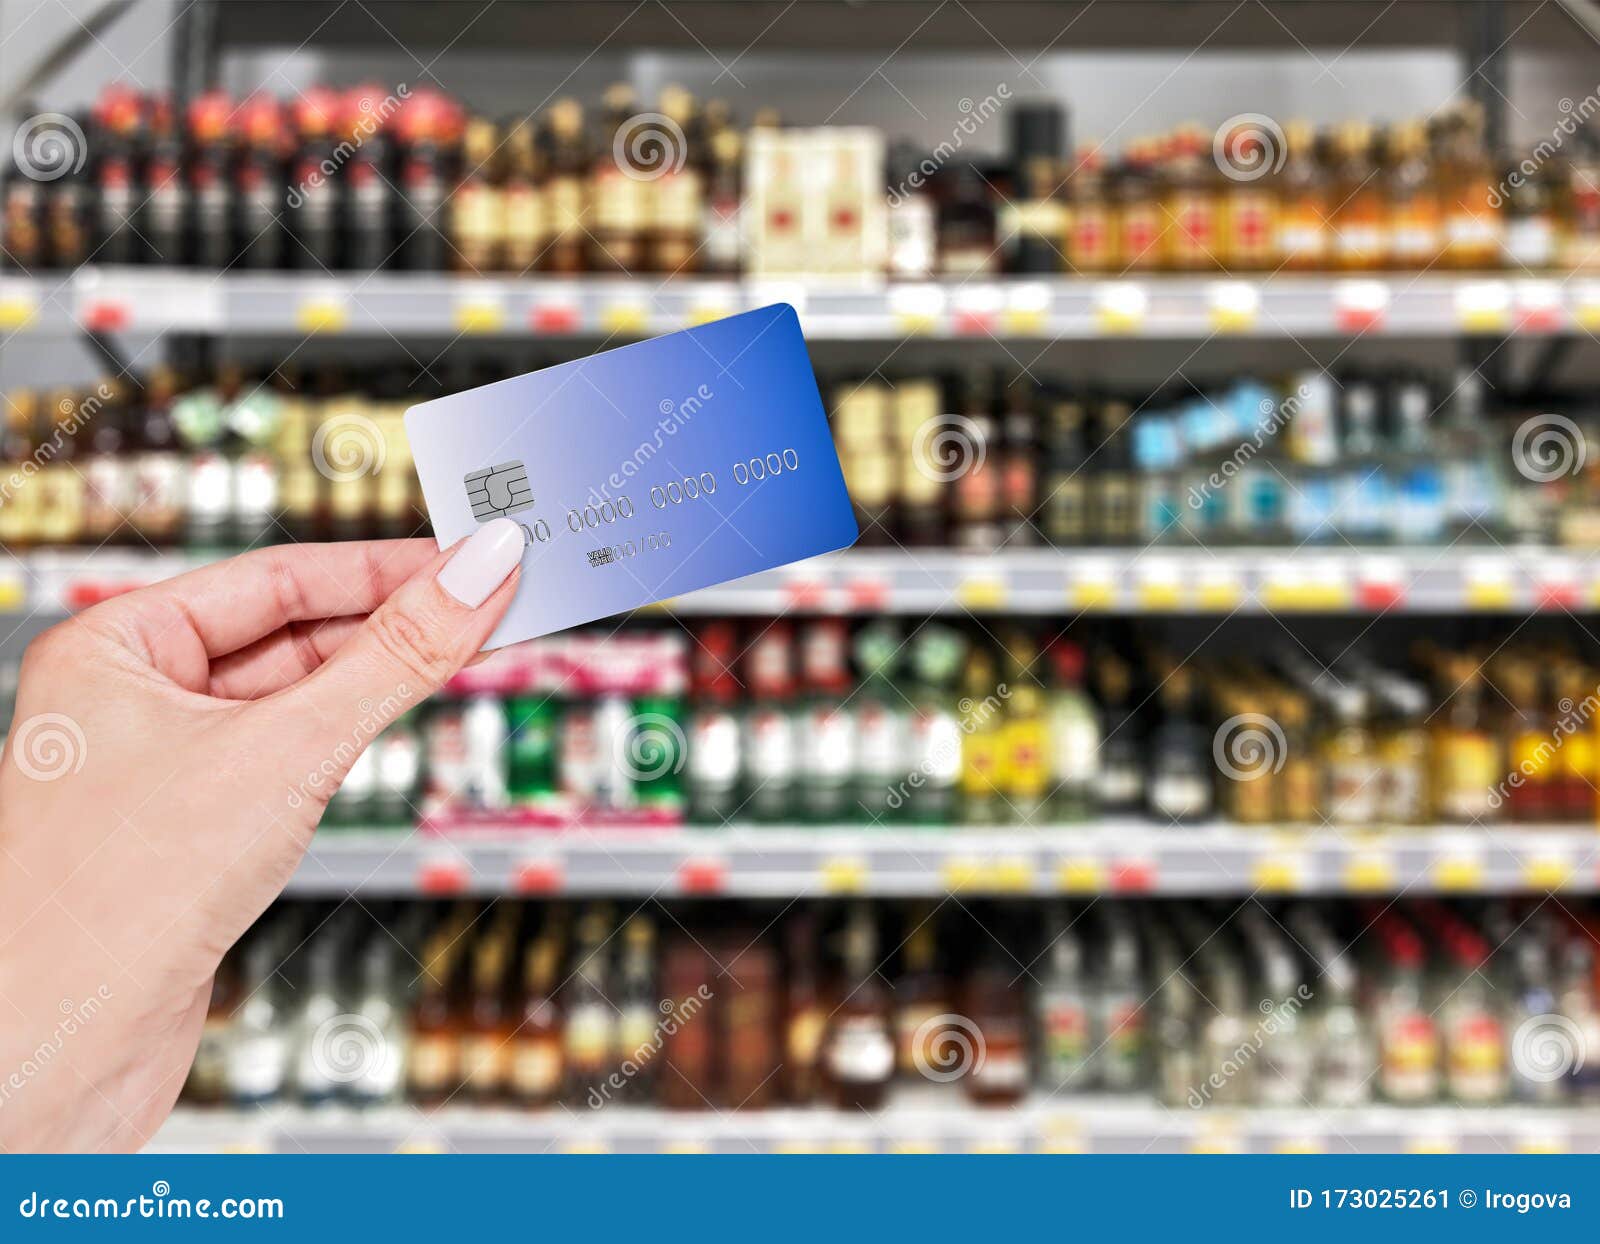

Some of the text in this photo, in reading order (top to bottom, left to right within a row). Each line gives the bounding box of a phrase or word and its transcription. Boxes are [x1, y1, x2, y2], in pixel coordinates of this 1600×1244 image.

[567, 495, 634, 533] 0000
[651, 471, 717, 509] 0000
[733, 448, 798, 485] 0000
